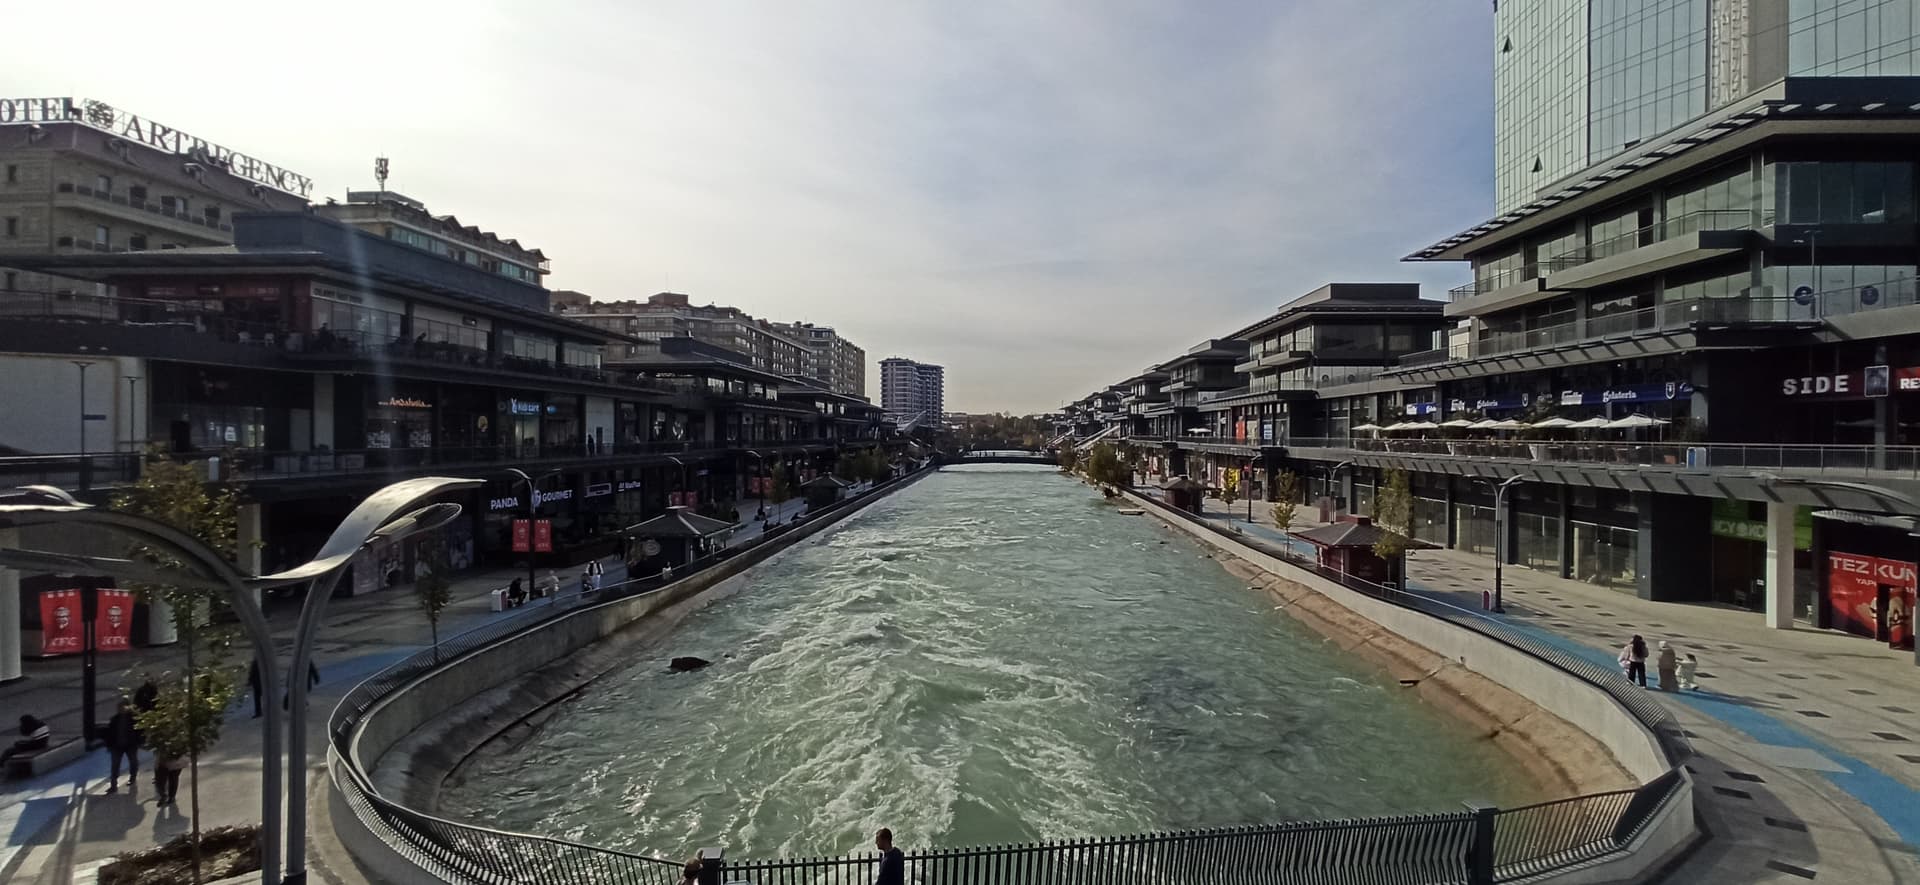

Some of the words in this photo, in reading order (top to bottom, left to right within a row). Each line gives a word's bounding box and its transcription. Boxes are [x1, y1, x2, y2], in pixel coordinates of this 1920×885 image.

[1783, 374, 1849, 395] SIDE
[490, 496, 519, 510] PANDA
[542, 489, 573, 502] GOURMET
[1829, 556, 1870, 575] TEZ
